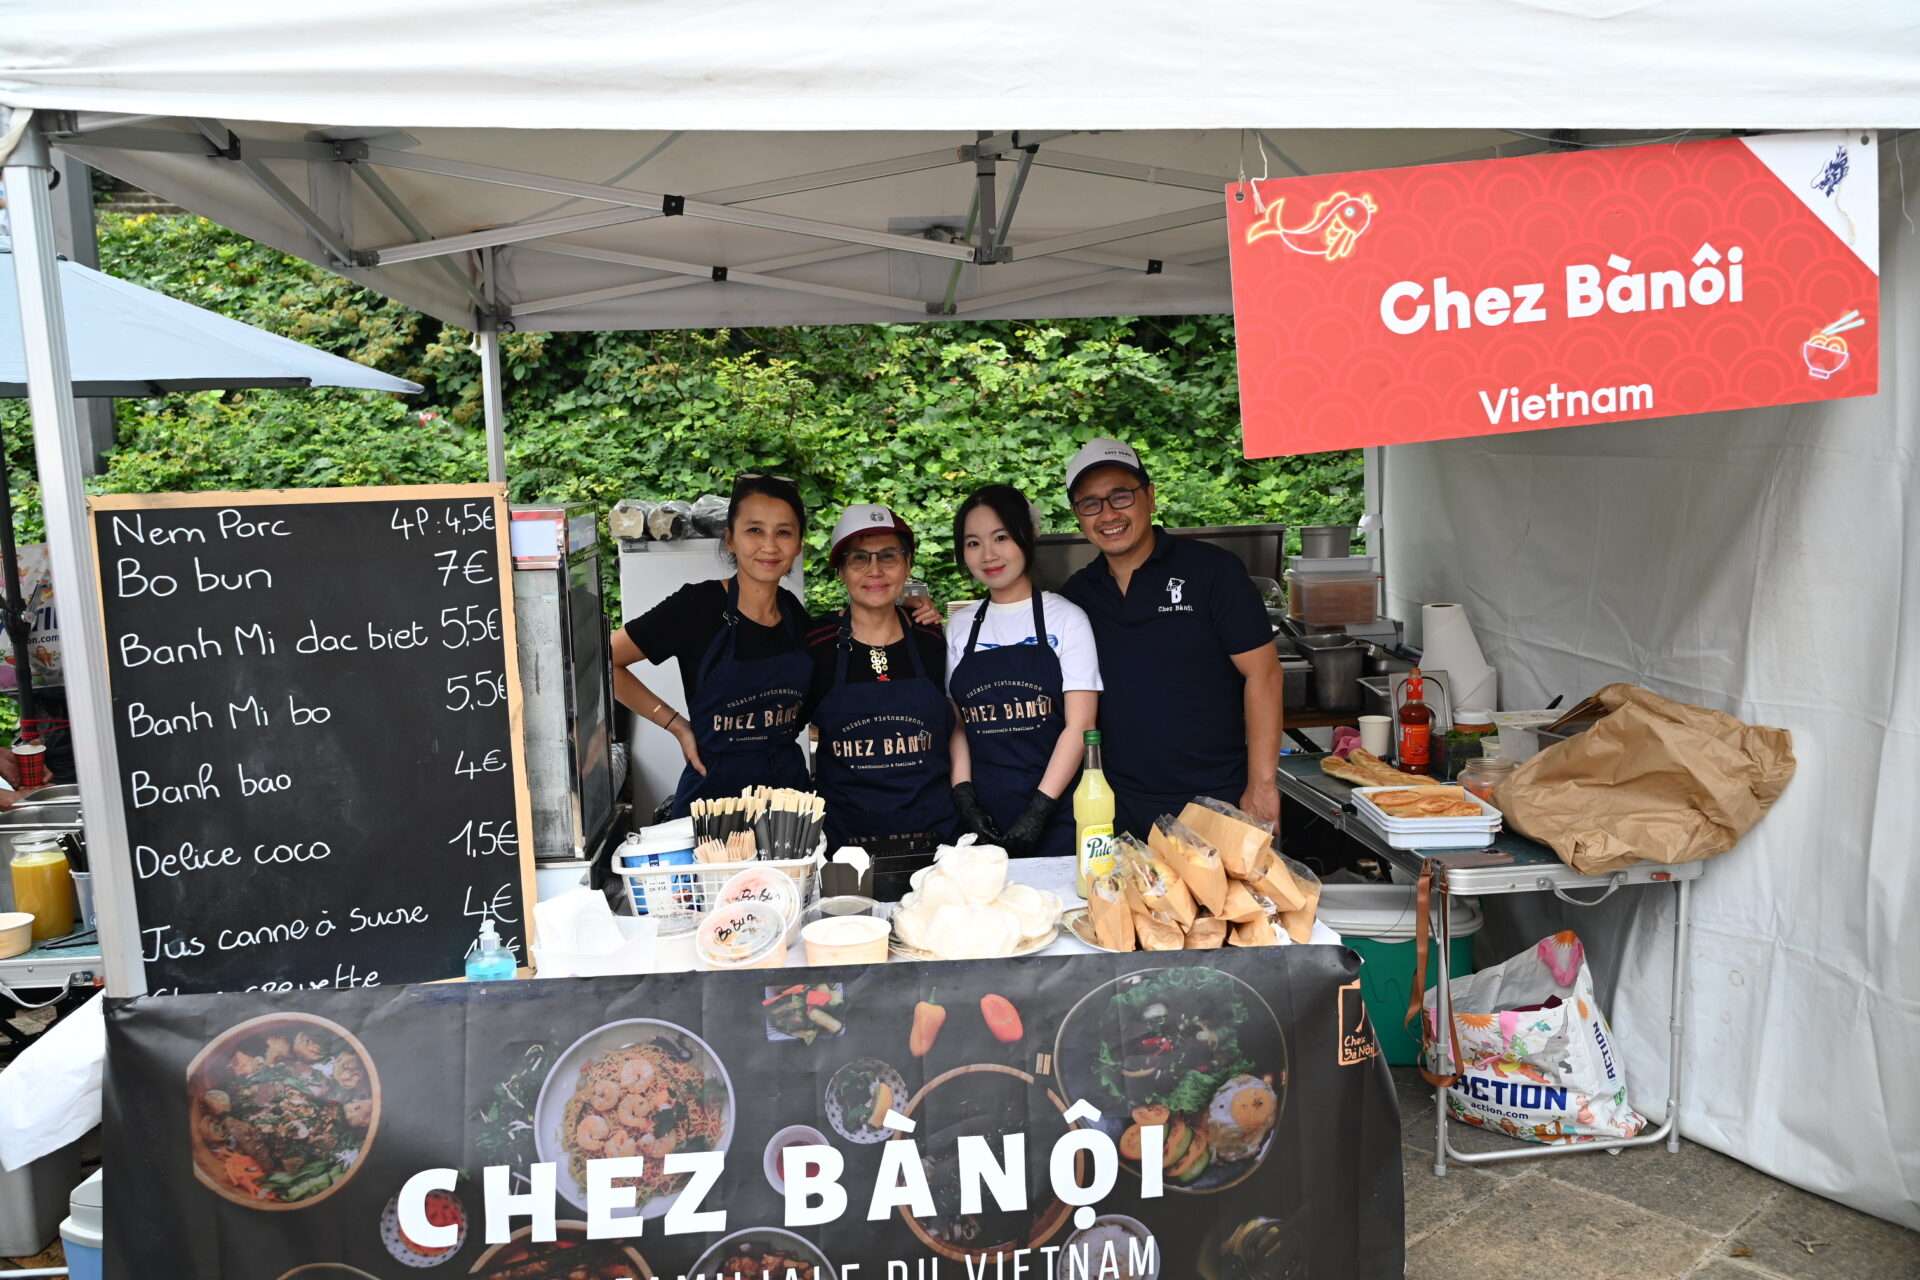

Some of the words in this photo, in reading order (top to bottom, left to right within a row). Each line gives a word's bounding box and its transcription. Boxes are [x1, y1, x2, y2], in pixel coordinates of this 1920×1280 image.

[1380, 277, 1546, 335] Chez
[1566, 242, 1743, 318] Bànôi
[1479, 383, 1653, 424] Vietnam
[112, 513, 206, 546] Nem
[217, 509, 293, 539] Porc
[117, 557, 178, 598] Bo
[194, 556, 272, 592] bun
[434, 549, 493, 587] 7€
[120, 627, 222, 668] Banh
[234, 623, 275, 656] Mi
[295, 619, 358, 654] dac
[368, 620, 429, 650] biet
[128, 701, 214, 738] Banh
[228, 695, 269, 729] Mi
[289, 695, 331, 726] bo
[713, 712, 756, 732] CHEZ
[961, 703, 997, 724] CHEZ
[832, 738, 875, 757] CHEZ
[131, 762, 221, 809] Banh
[237, 763, 292, 797] bao
[454, 749, 507, 780] 4€
[135, 841, 242, 879] Delice
[254, 841, 331, 865] coco
[142, 924, 206, 963] Jus
[218, 918, 310, 950] canne
[463, 883, 518, 924] 4€
[1594, 1021, 1616, 1079] ACTION
[1451, 1076, 1568, 1111] ACTION
[1470, 1101, 1529, 1120] action.com
[398, 1150, 727, 1248] CHEZ
[782, 1098, 1164, 1230] BÀNỘI
[965, 1235, 1155, 1280] VIETNAM
